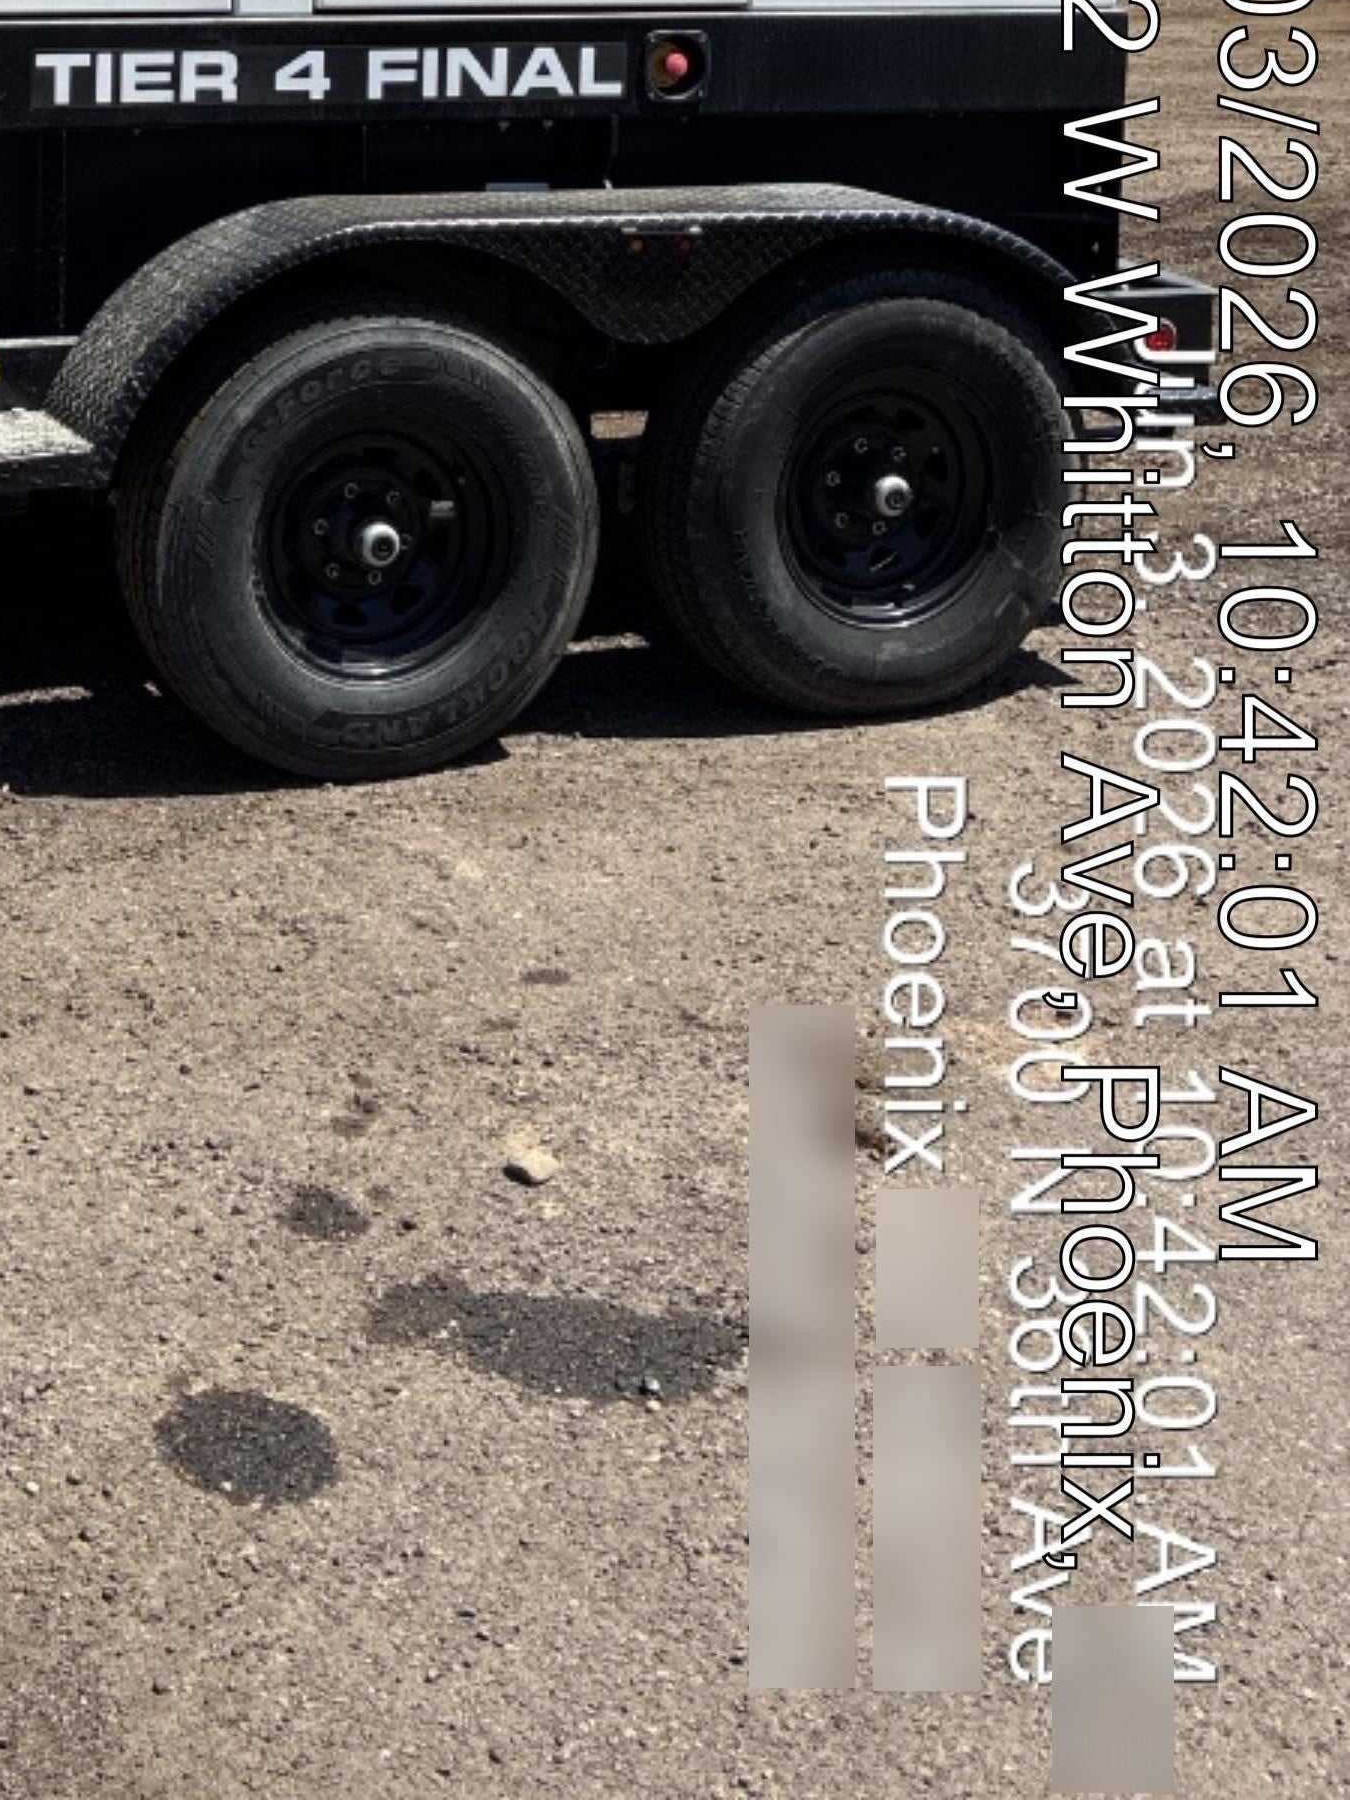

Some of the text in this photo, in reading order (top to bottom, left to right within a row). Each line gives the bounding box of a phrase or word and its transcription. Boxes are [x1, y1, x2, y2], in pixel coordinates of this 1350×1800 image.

[35, 46, 623, 104] TIER 4 FINAL
